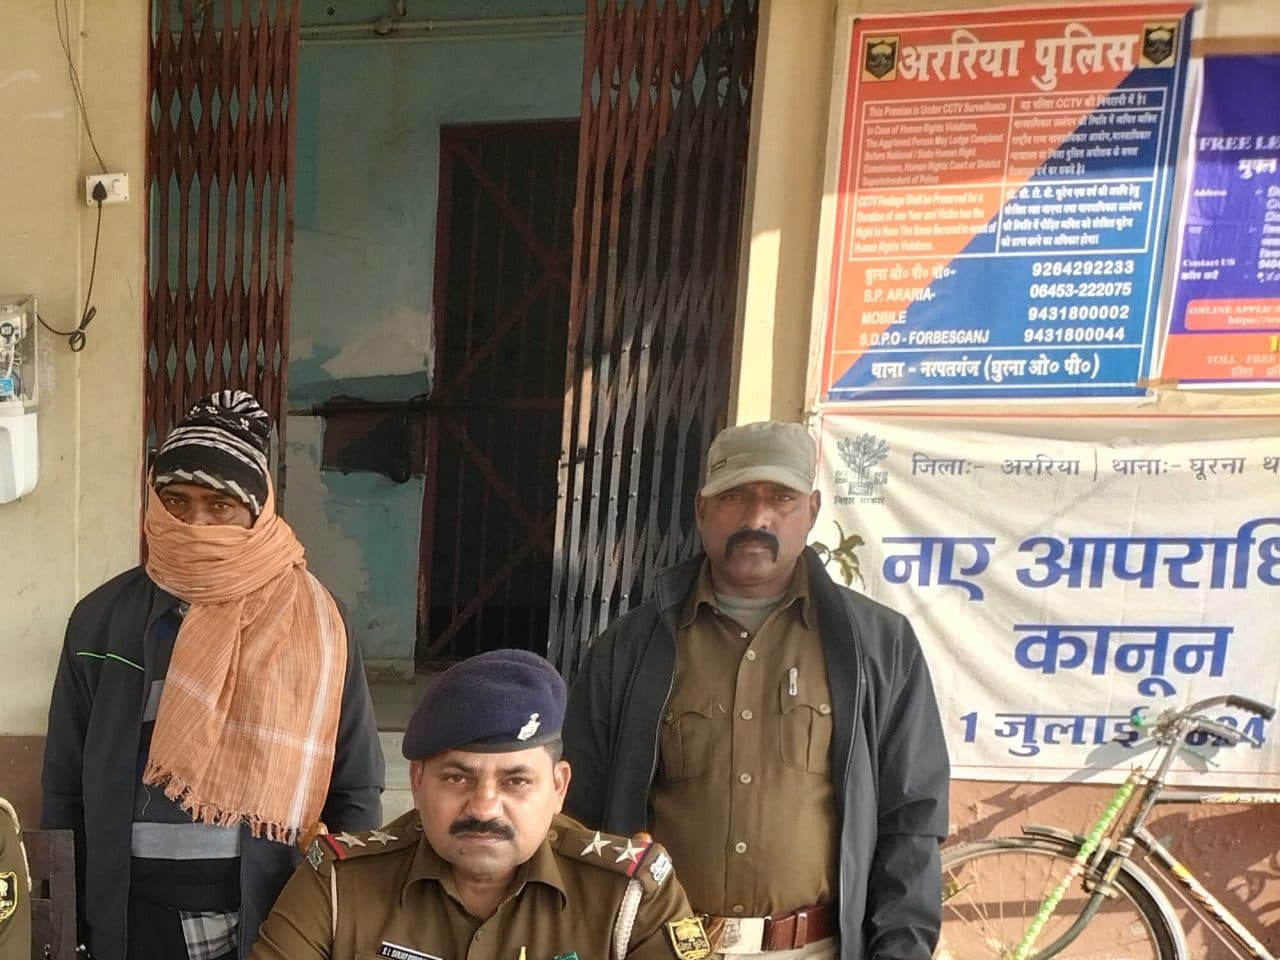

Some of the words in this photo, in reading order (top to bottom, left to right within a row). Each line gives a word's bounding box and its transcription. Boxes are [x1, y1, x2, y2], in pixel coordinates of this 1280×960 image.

[898, 29, 1024, 81] अररिया
[1031, 22, 1139, 91] पुलिस
[943, 102, 963, 114] CCTV
[1056, 98, 1083, 108] CCTV
[1199, 135, 1253, 151] FREE
[1031, 259, 1135, 277] 9264292233
[1182, 257, 1219, 268] Contact
[863, 289, 886, 303] S.P.
[886, 287, 936, 302] ARARIA-
[1029, 281, 1133, 299] 06453-222075
[861, 310, 907, 325] MOBILE
[1028, 304, 1130, 321] 9431800002
[908, 329, 990, 346] FORBESGANJ
[1023, 326, 1126, 344] 9431800044
[871, 361, 906, 379] थाना
[919, 355, 982, 378] नरपतगंज
[1001, 452, 1081, 477] अररिया
[882, 536, 997, 602] नए
[1012, 623, 1235, 699] कानून
[960, 711, 979, 744] 1
